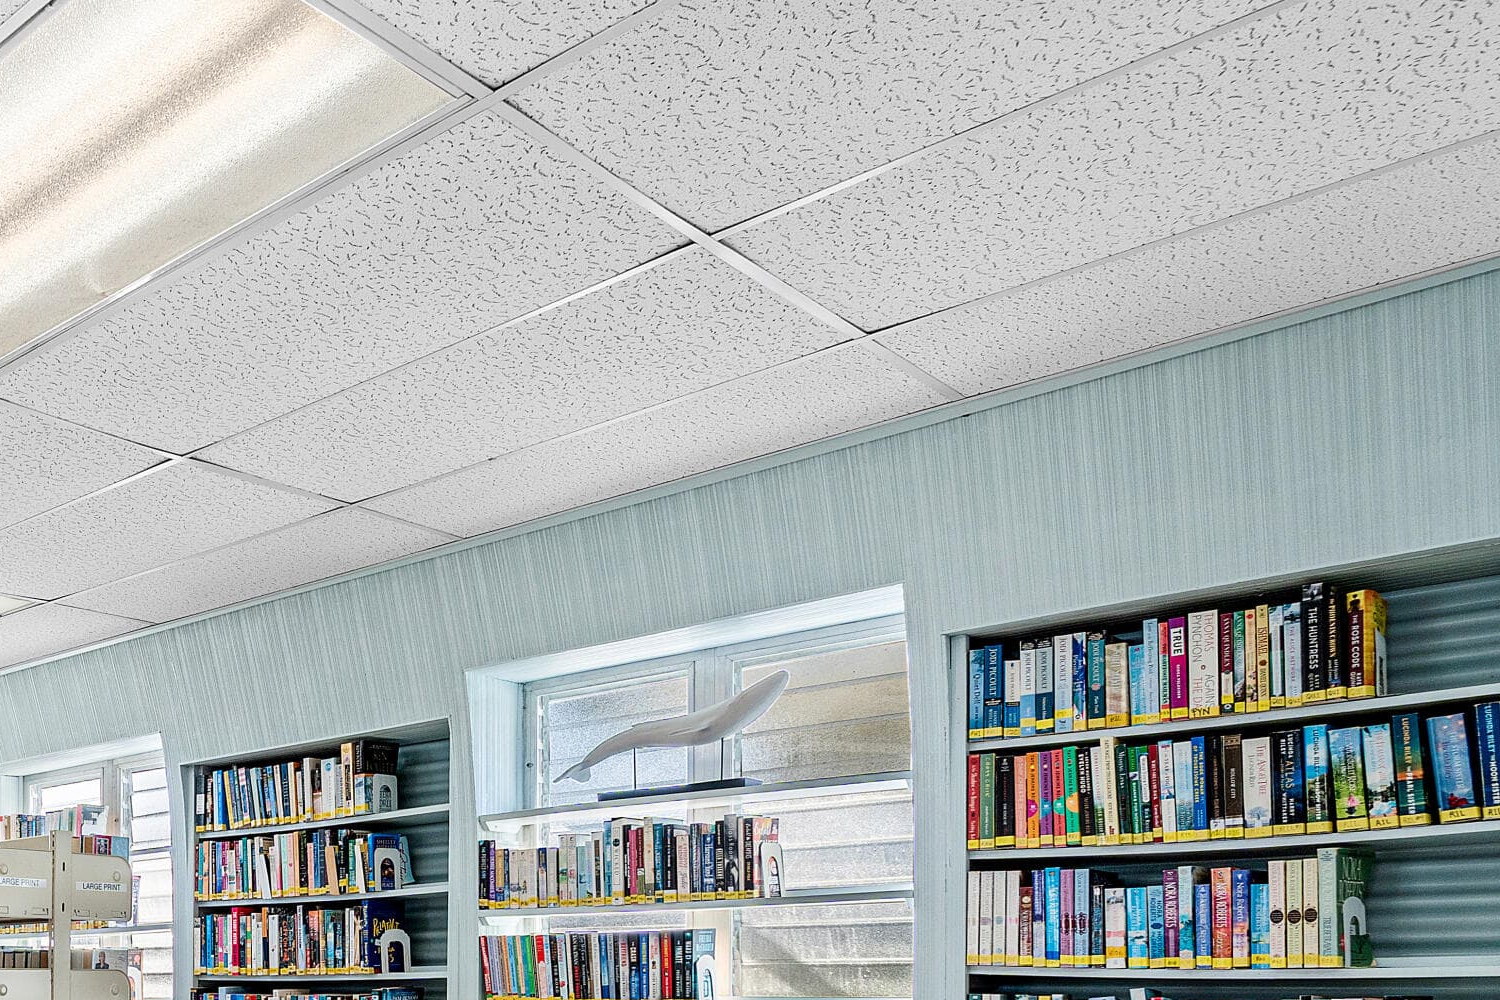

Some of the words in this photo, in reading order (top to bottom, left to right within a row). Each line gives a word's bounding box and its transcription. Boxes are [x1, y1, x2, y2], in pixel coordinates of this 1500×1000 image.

[1308, 607, 1317, 624] THE
[1172, 629, 1182, 654] TRUE
[1192, 615, 1202, 663] PYNCHON
[1204, 613, 1214, 652] THOMAS
[1258, 627, 1268, 656] ISHMAEL
[1350, 625, 1359, 645] ROSE
[988, 648, 997, 665] JODI
[1308, 625, 1318, 670] HUNTRESS
[1351, 647, 1360, 668] CODE
[989, 667, 998, 697] PICOULT
[1193, 677, 1202, 694] THE
[1484, 705, 1493, 731] LUCINDA
[1401, 717, 1410, 745] LUCINDA
[1486, 732, 1494, 753] RILEY
[1404, 746, 1412, 764] RILEY
[1284, 760, 1293, 789] ATLAS
[1489, 761, 1497, 782] MOON
[1491, 783, 1499, 804] SISTER
[21, 879, 39, 887] PRINT
[104, 883, 121, 891] PRINT
[1165, 882, 1176, 900] NORA
[1217, 883, 1227, 900] NORA
[1166, 901, 1176, 928] ROBERTS
